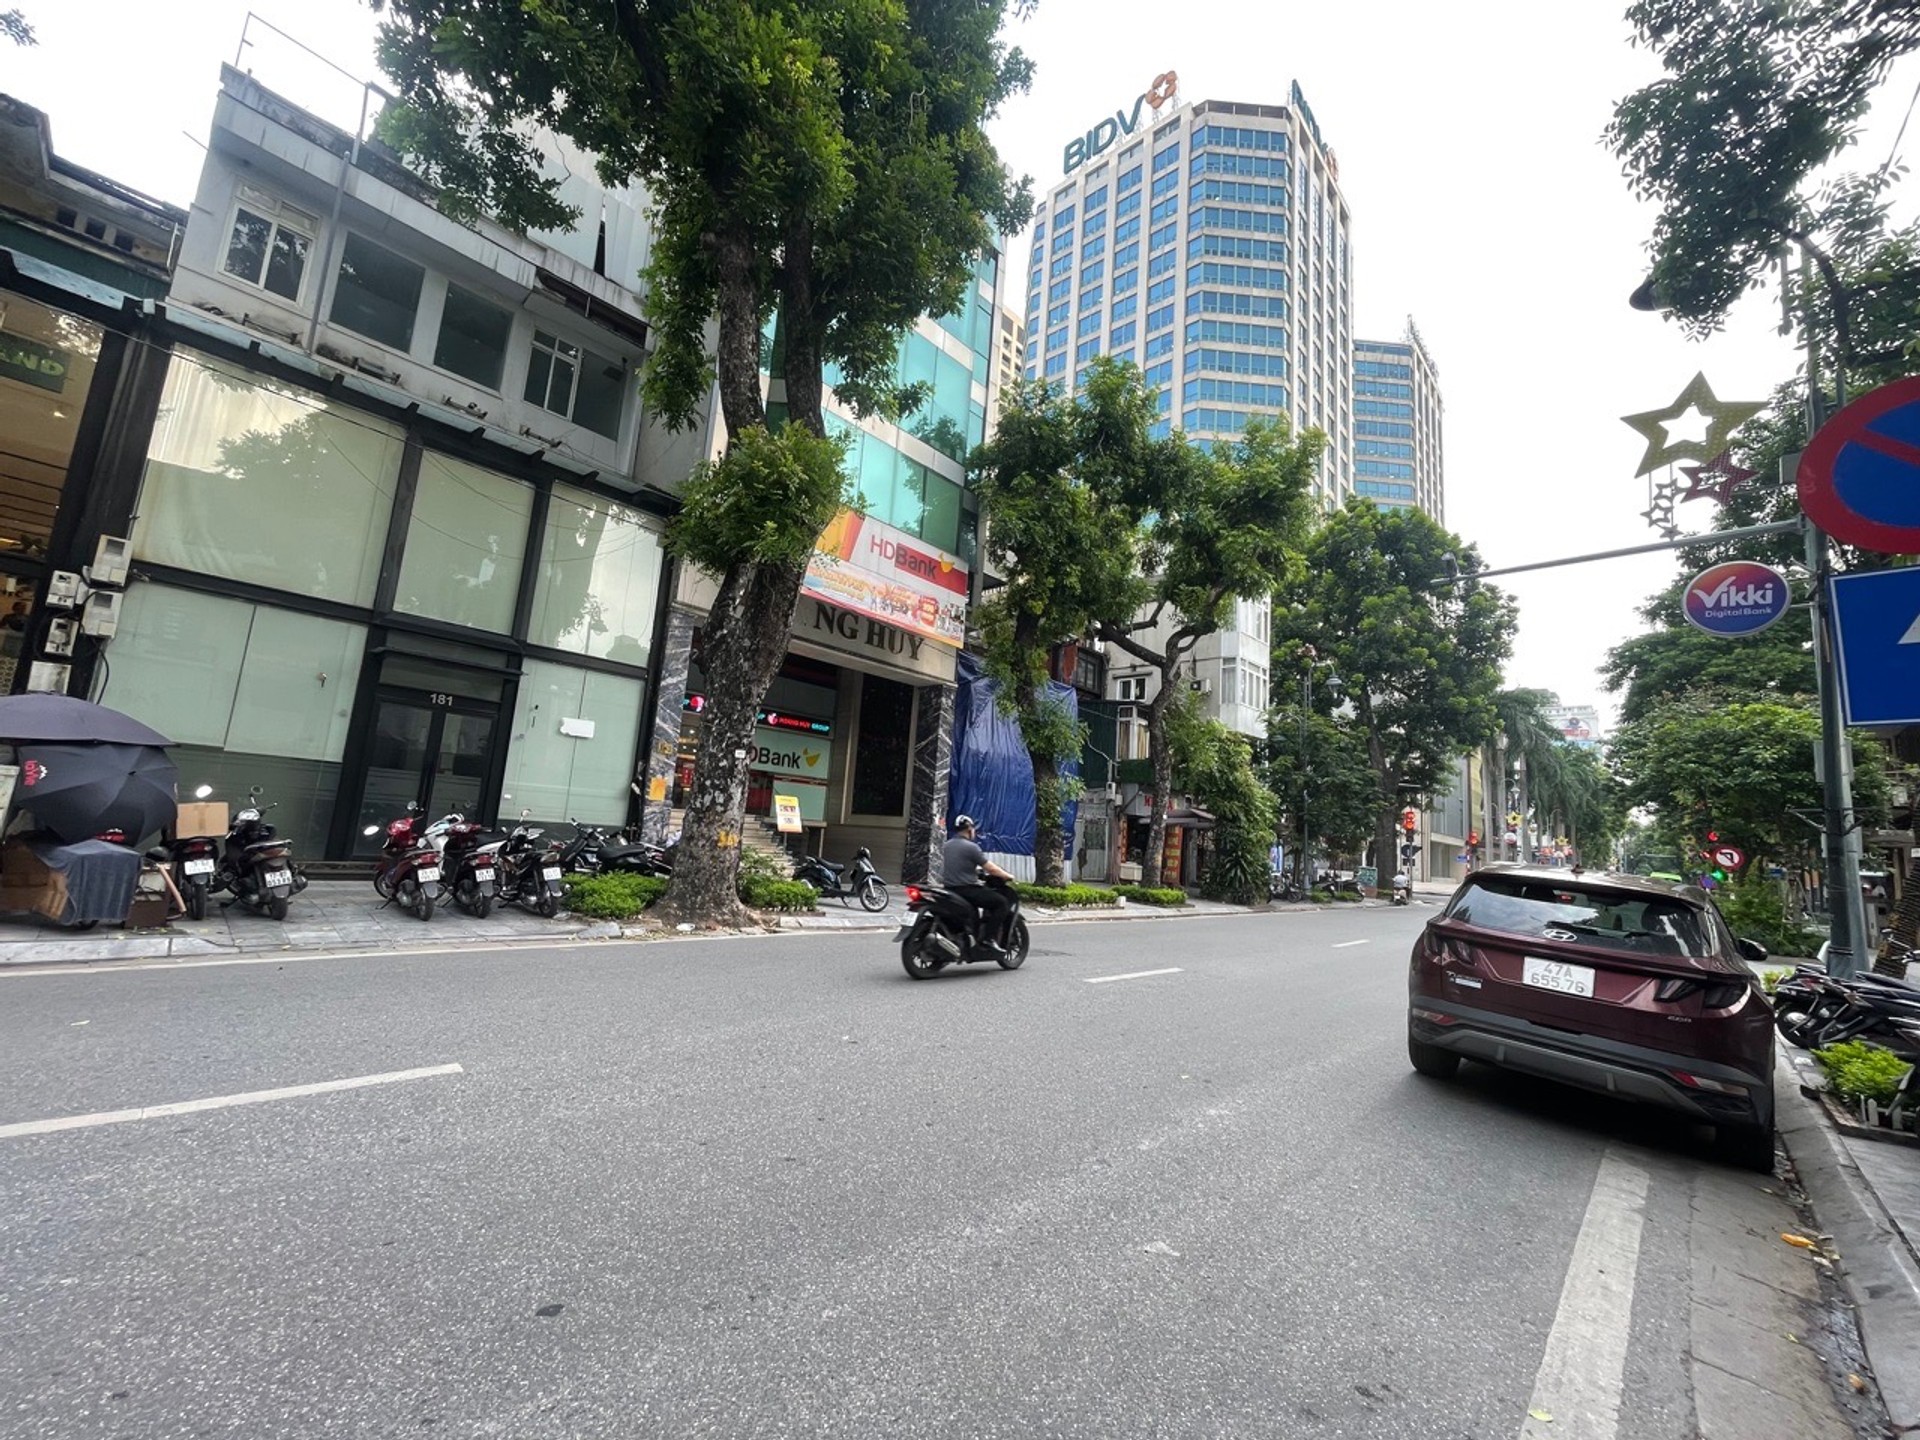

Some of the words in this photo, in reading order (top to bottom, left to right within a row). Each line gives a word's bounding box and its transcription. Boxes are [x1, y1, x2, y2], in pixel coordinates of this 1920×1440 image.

[1064, 93, 1146, 175] BIDV
[870, 534, 938, 580] HDBank
[1692, 576, 1773, 608] Vikki
[1705, 608, 1742, 618] Digital
[1743, 607, 1773, 616] Bank
[864, 617, 925, 660] HUY
[430, 693, 453, 706] 181
[1531, 973, 1586, 993] 655.76
[1544, 962, 1572, 978] 47A
